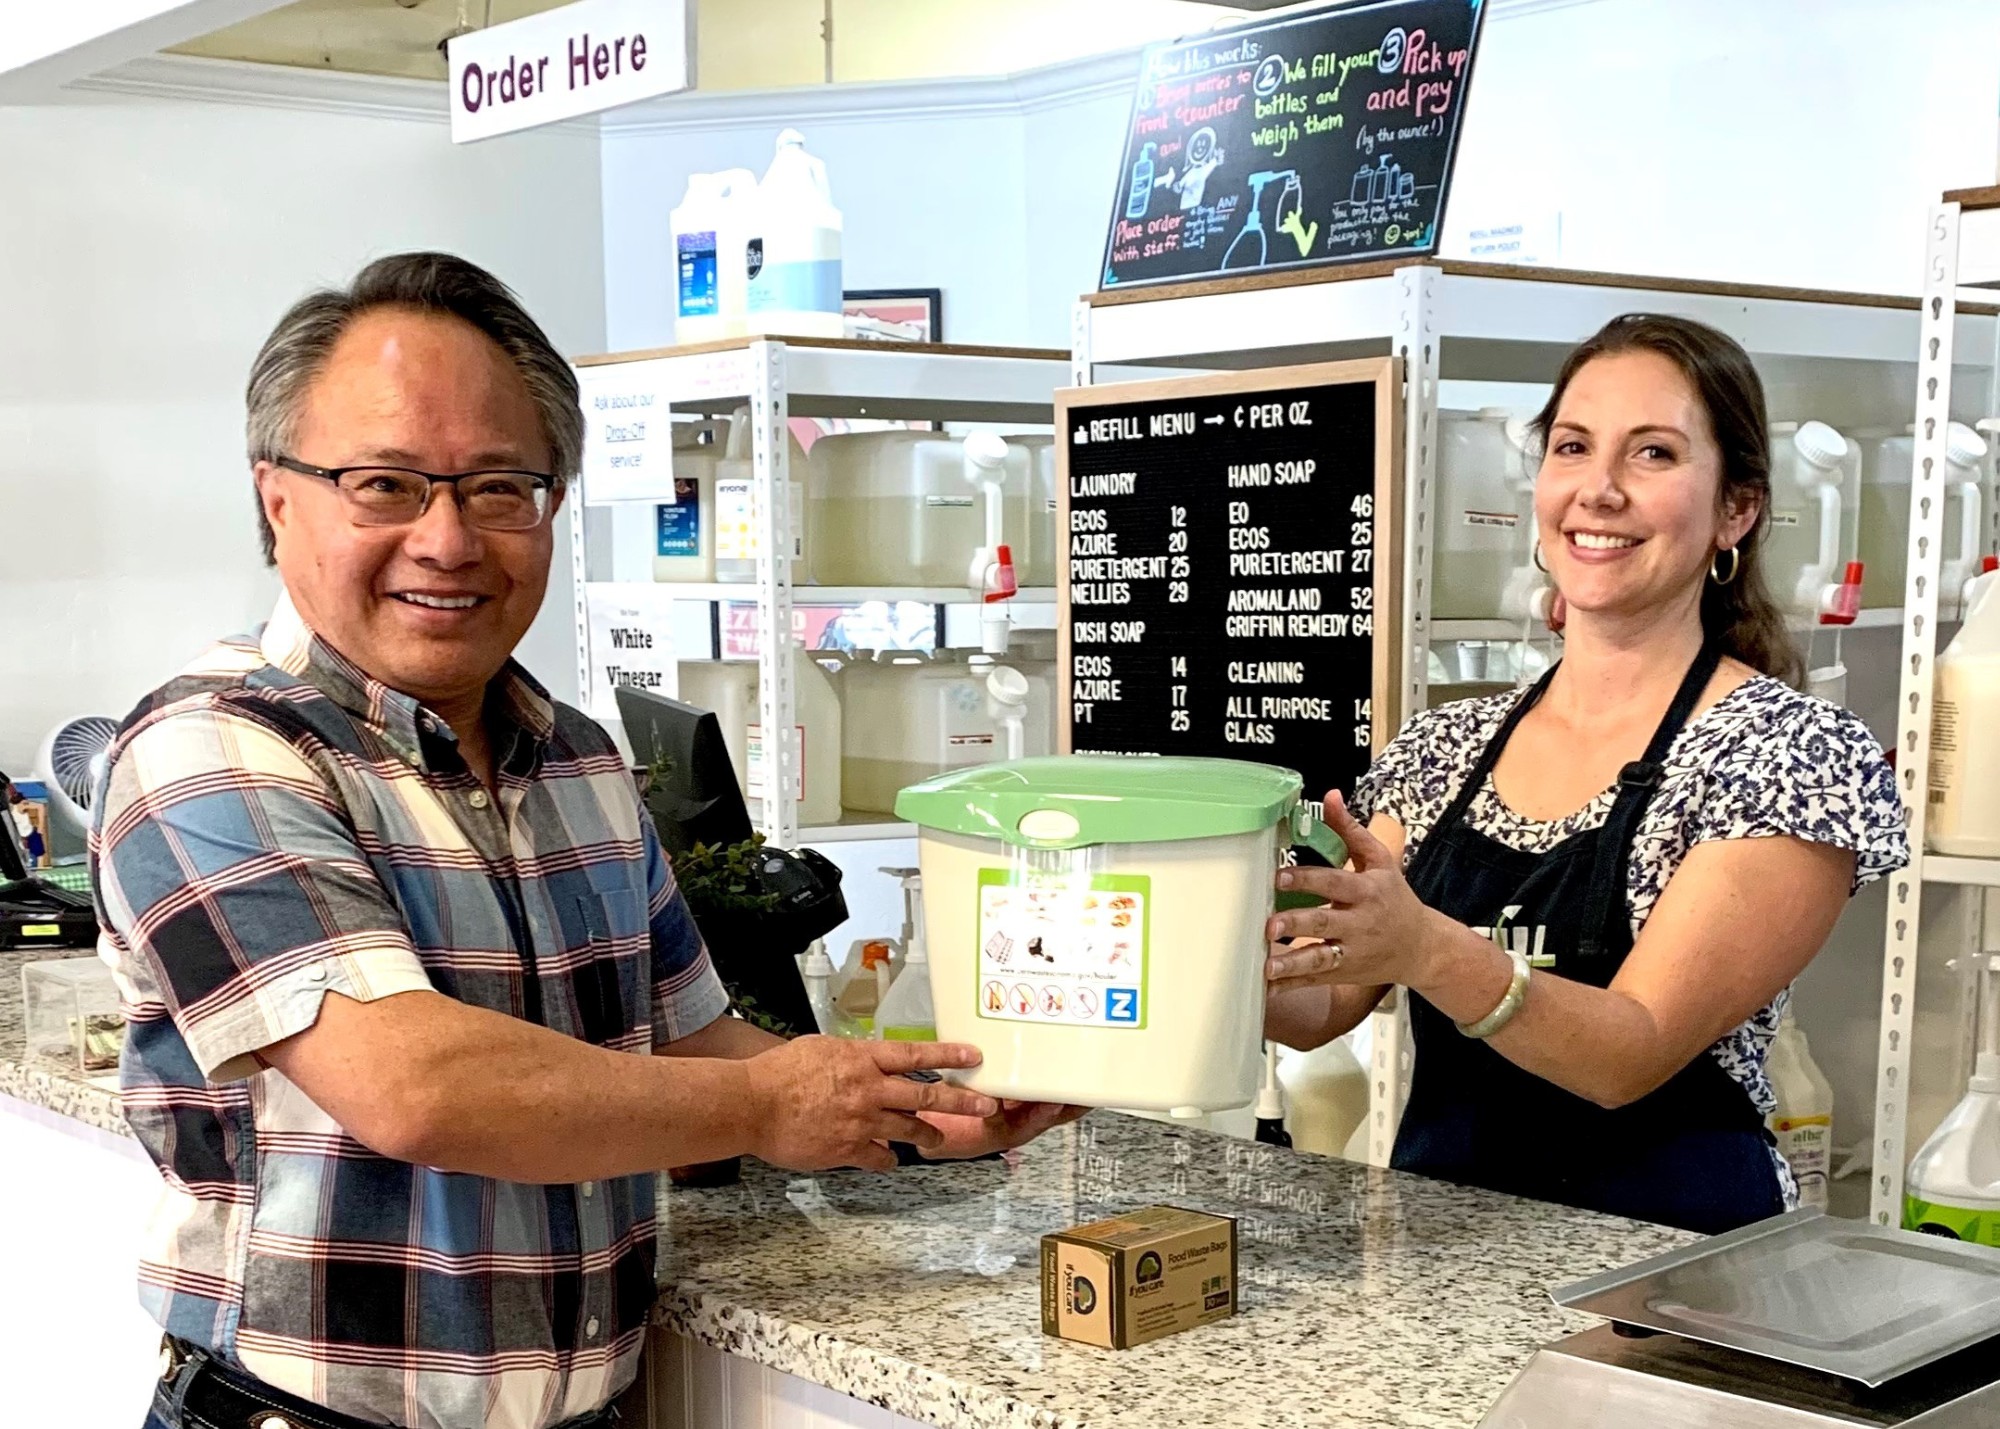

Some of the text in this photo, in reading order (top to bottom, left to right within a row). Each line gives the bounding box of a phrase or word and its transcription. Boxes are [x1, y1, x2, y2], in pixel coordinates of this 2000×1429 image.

[1184, 47, 1210, 73] this
[1215, 38, 1263, 64] works:
[1402, 29, 1443, 75] Pick
[1447, 48, 1467, 78] up
[462, 33, 647, 113] Order Here
[1237, 70, 1251, 85] to
[1284, 58, 1306, 84] We
[1311, 52, 1336, 80] fill
[1339, 48, 1380, 87] your
[1255, 86, 1340, 119] bottles and
[1366, 79, 1453, 117] and pay
[1251, 113, 1344, 158] weigh them
[1377, 127, 1395, 141] the
[1398, 115, 1444, 140] ounce!)
[1216, 195, 1239, 210] ANY
[1115, 214, 1185, 247] Place order
[1113, 245, 1139, 262] with
[594, 393, 655, 410] Ask about our
[606, 422, 645, 442] Drop-Off
[1091, 417, 1143, 441] REFILL
[1150, 412, 1195, 436] MENU
[1250, 404, 1283, 428] PER
[1289, 401, 1312, 425] OZ
[1071, 473, 1136, 497] LAUNDRY
[1229, 459, 1315, 487] HAND SOAP
[1071, 506, 1186, 531] ECOS 12
[1229, 494, 1372, 524] EO 46
[1071, 531, 1187, 555] AZURE 20
[1229, 522, 1371, 550] ECOS 25
[1070, 556, 1190, 578] PURETERGENT 25
[1230, 549, 1371, 576] PURETERGENT 27
[1071, 582, 1188, 604] NELLIES 29
[1228, 587, 1372, 611] AROMALAND 52
[610, 627, 653, 649] White
[1074, 621, 1145, 642] DISH SOAP
[1226, 614, 1372, 637] GRIFFIN REMEDY 64
[606, 665, 662, 691] Vinegar
[1075, 656, 1186, 677] ECOS 14
[1228, 662, 1303, 683] CLEANING
[1074, 680, 1187, 706] AZURE 17
[1075, 703, 1189, 731] PT 25
[1227, 697, 1371, 720] ALL PURPOSE 14
[1225, 721, 1370, 746] GLASS 15
[1112, 993, 1132, 1018] Z
[1168, 1240, 1228, 1265] Food Waste Bags
[1064, 1270, 1072, 1292] you
[1134, 1284, 1149, 1298] you
[1148, 1279, 1164, 1292] care
[1065, 1292, 1073, 1315] care
